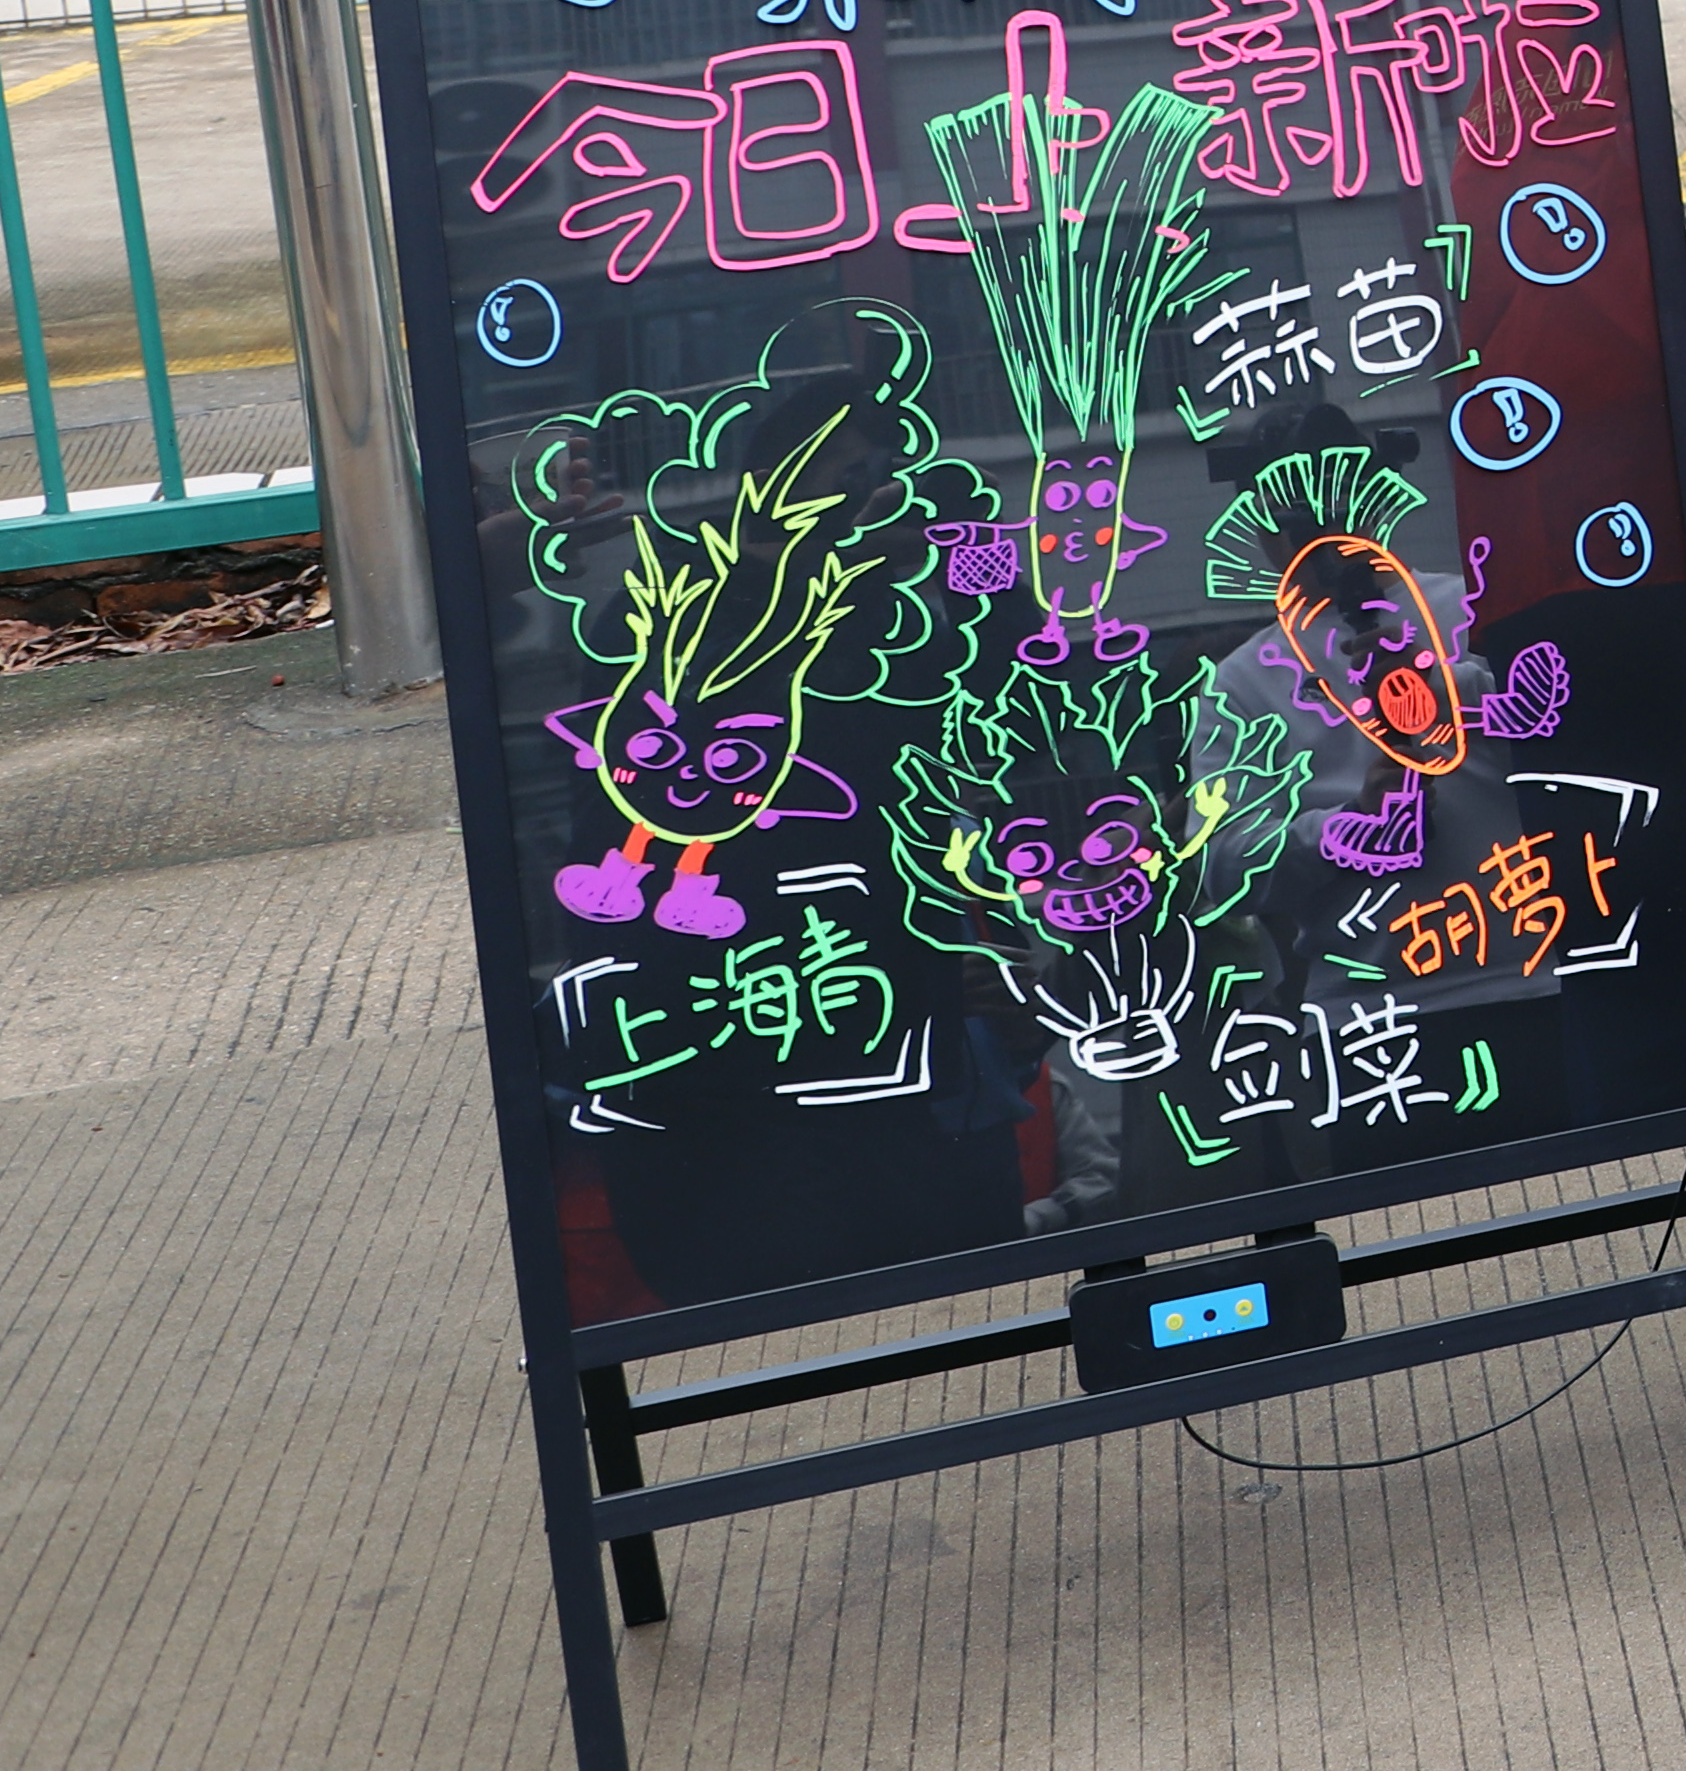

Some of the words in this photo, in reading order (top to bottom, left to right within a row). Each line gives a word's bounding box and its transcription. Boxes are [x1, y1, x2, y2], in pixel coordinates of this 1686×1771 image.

[1388, 830, 1623, 981] 胡萝卜
[584, 906, 895, 1096] 上海青
